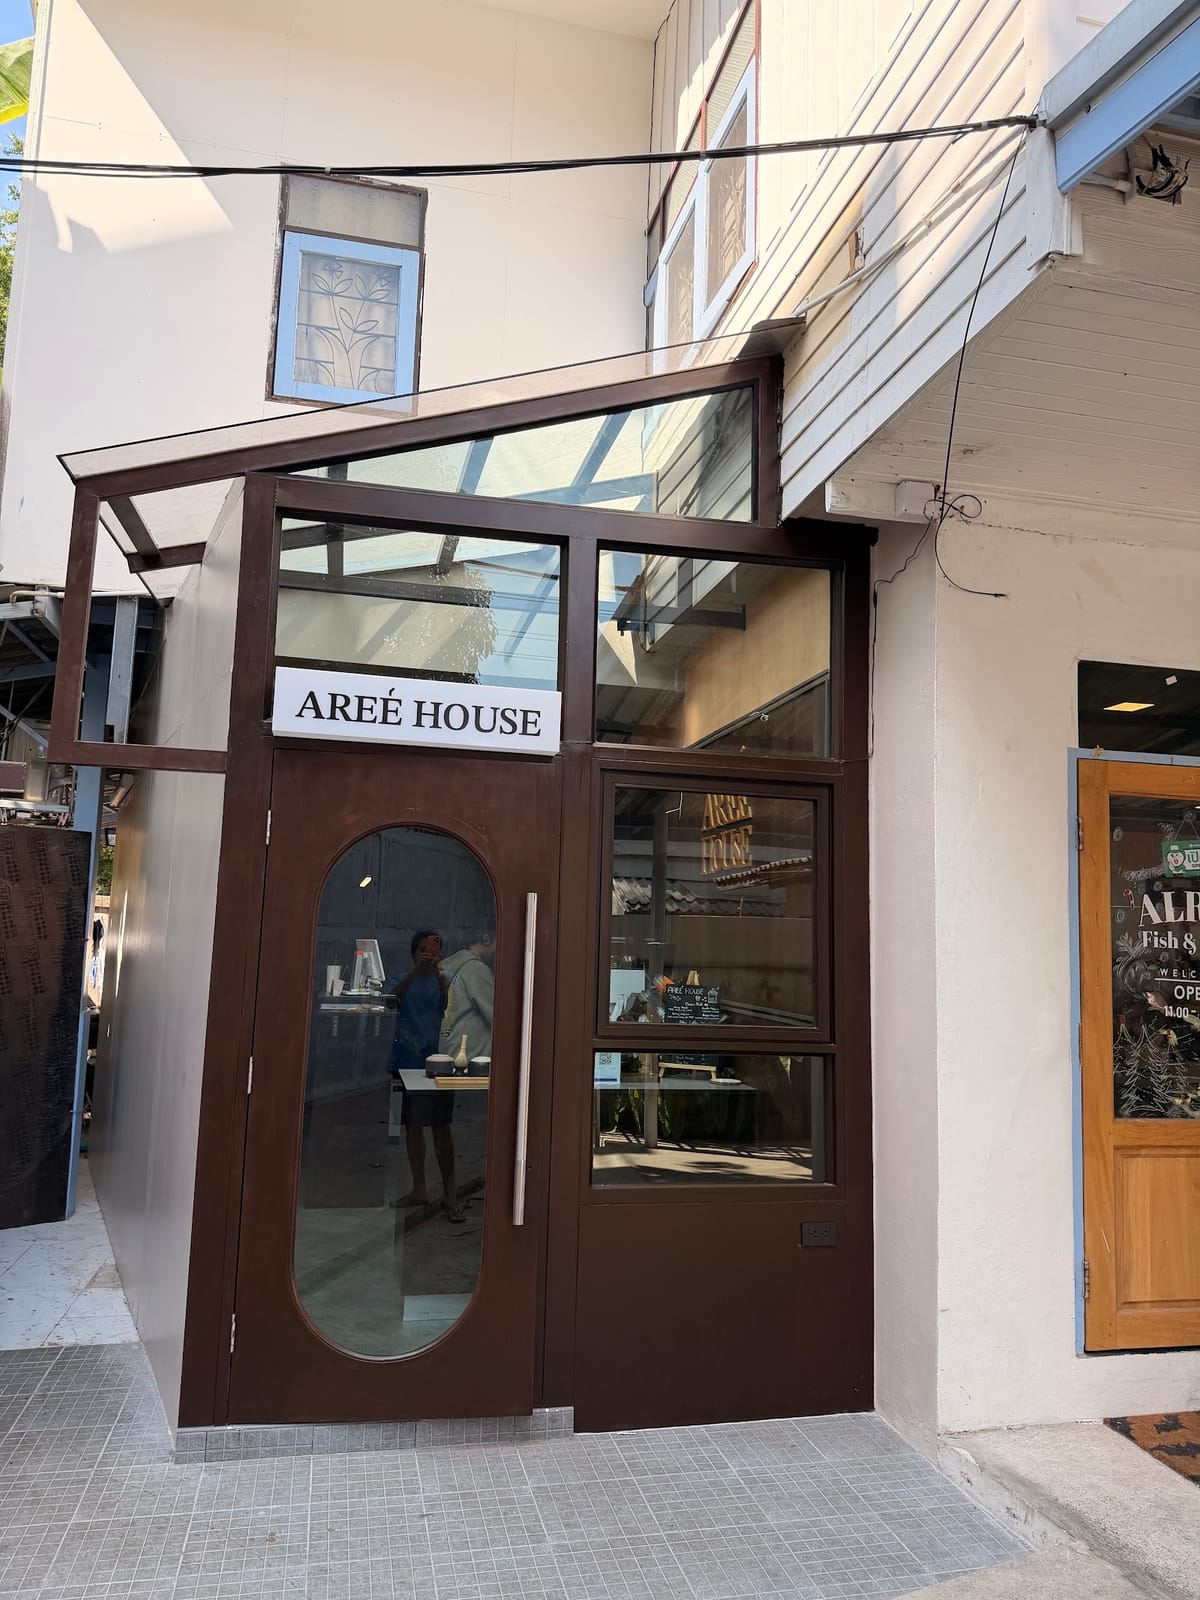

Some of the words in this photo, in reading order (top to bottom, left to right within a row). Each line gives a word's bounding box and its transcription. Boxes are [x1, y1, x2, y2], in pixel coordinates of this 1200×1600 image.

[295, 688, 402, 725] AREÉ
[412, 700, 541, 736] HOUSE
[701, 825, 752, 875] HOUSE
[1142, 931, 1179, 949] Fish
[1183, 932, 1197, 955] &
[1160, 968, 1196, 978] WELC
